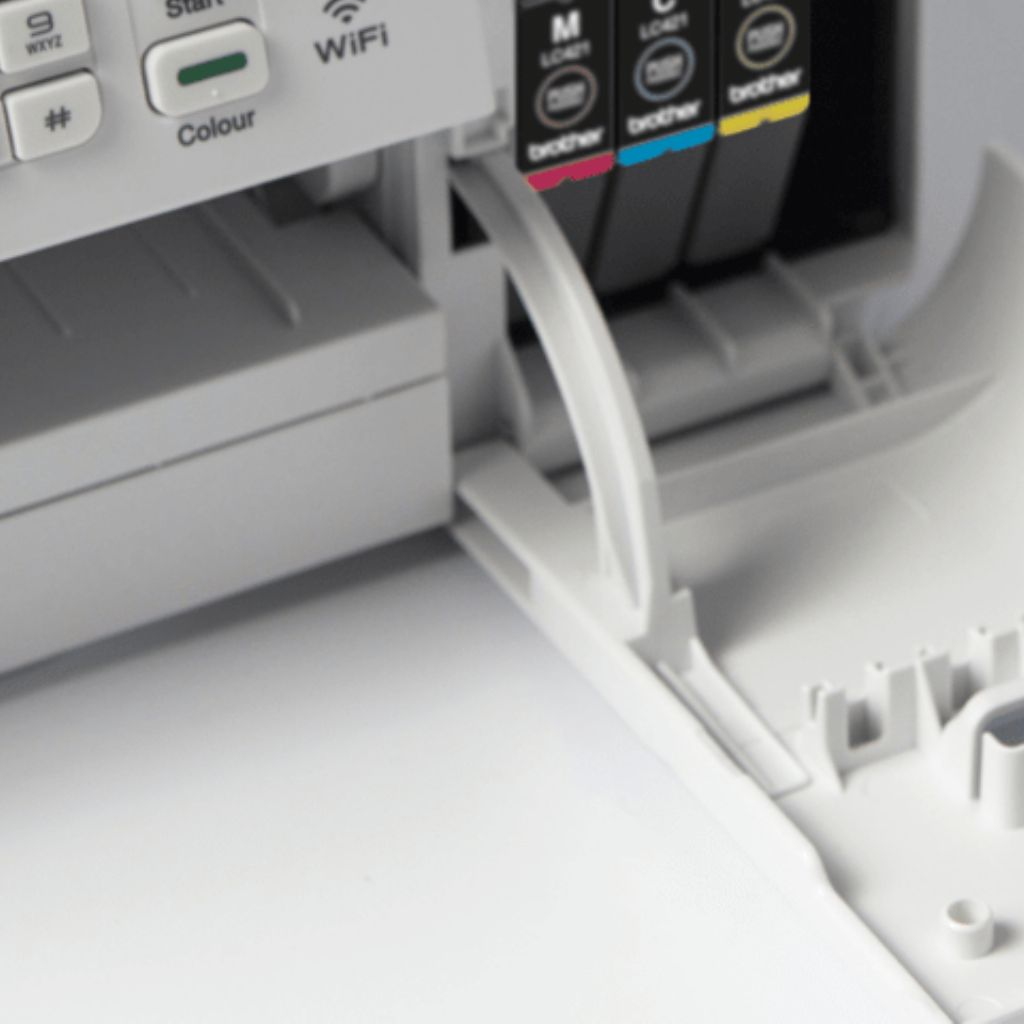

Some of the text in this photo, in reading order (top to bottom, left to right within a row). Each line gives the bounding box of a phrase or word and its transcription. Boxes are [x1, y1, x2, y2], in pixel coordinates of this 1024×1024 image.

[26, 10, 54, 37] 9
[551, 9, 581, 44] M
[638, 11, 690, 41] LC421
[25, 34, 63, 56] WXYZ
[314, 22, 389, 64] WiFi
[539, 39, 592, 69] LC421
[728, 67, 804, 104] brother
[45, 106, 72, 132] #
[177, 109, 256, 147] Colour
[626, 99, 702, 136] brother
[527, 127, 605, 163] brother
